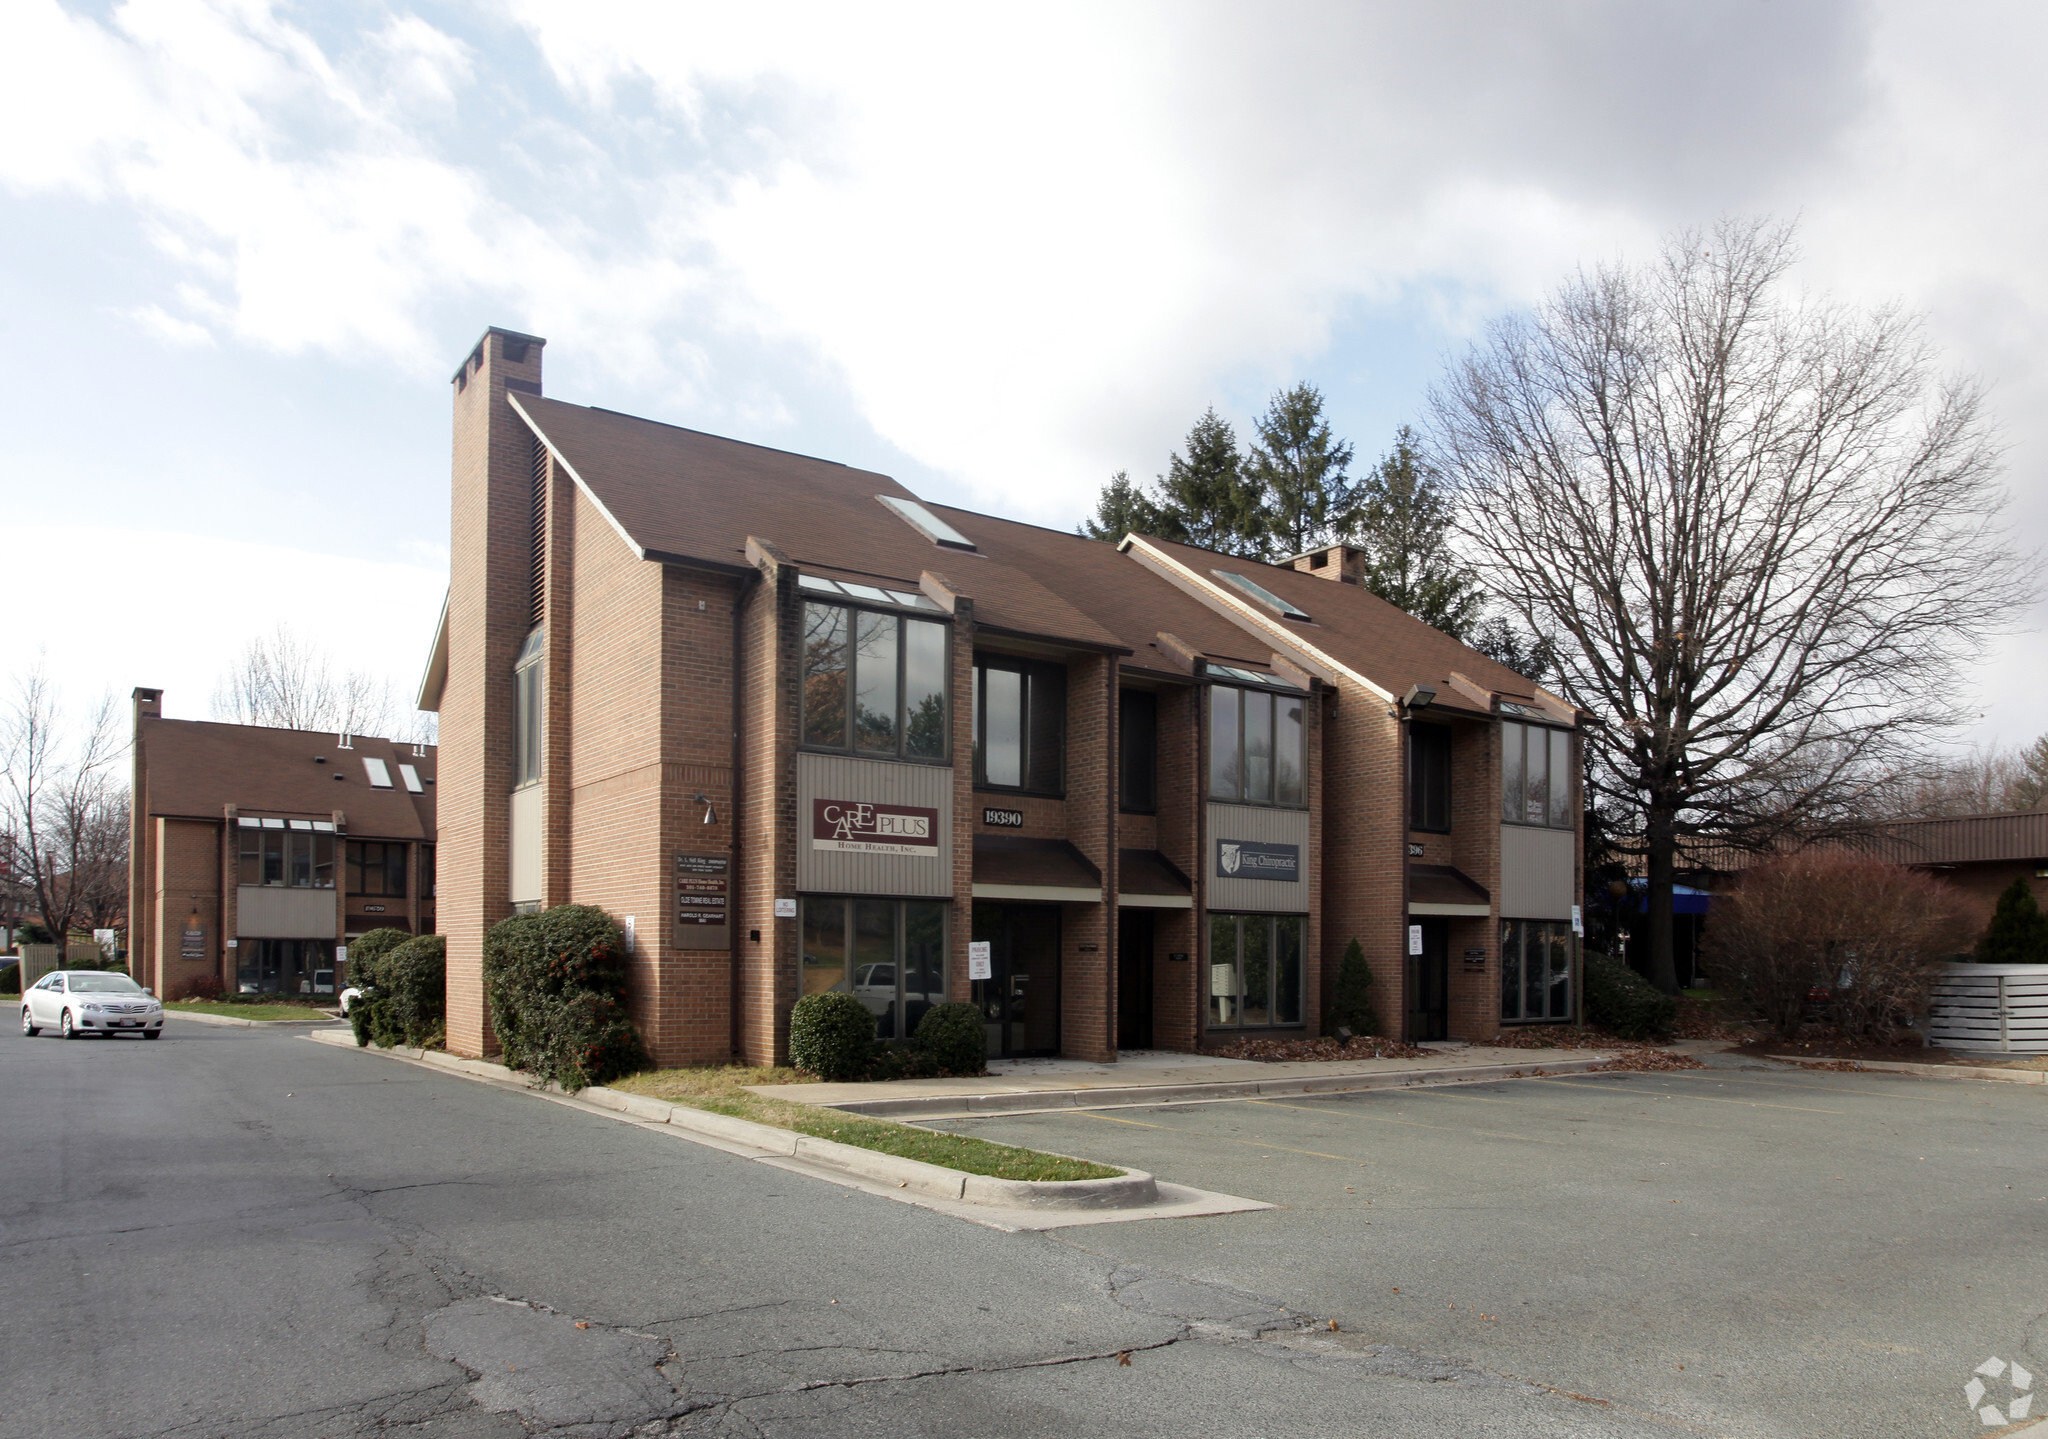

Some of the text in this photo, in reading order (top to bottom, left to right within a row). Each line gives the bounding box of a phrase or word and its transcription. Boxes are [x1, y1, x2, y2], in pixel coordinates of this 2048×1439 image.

[824, 803, 926, 840] CARE PLUS
[985, 810, 1022, 826] 19390
[1242, 854, 1296, 869] King Chiropractic
[712, 897, 724, 905] ESTATE
